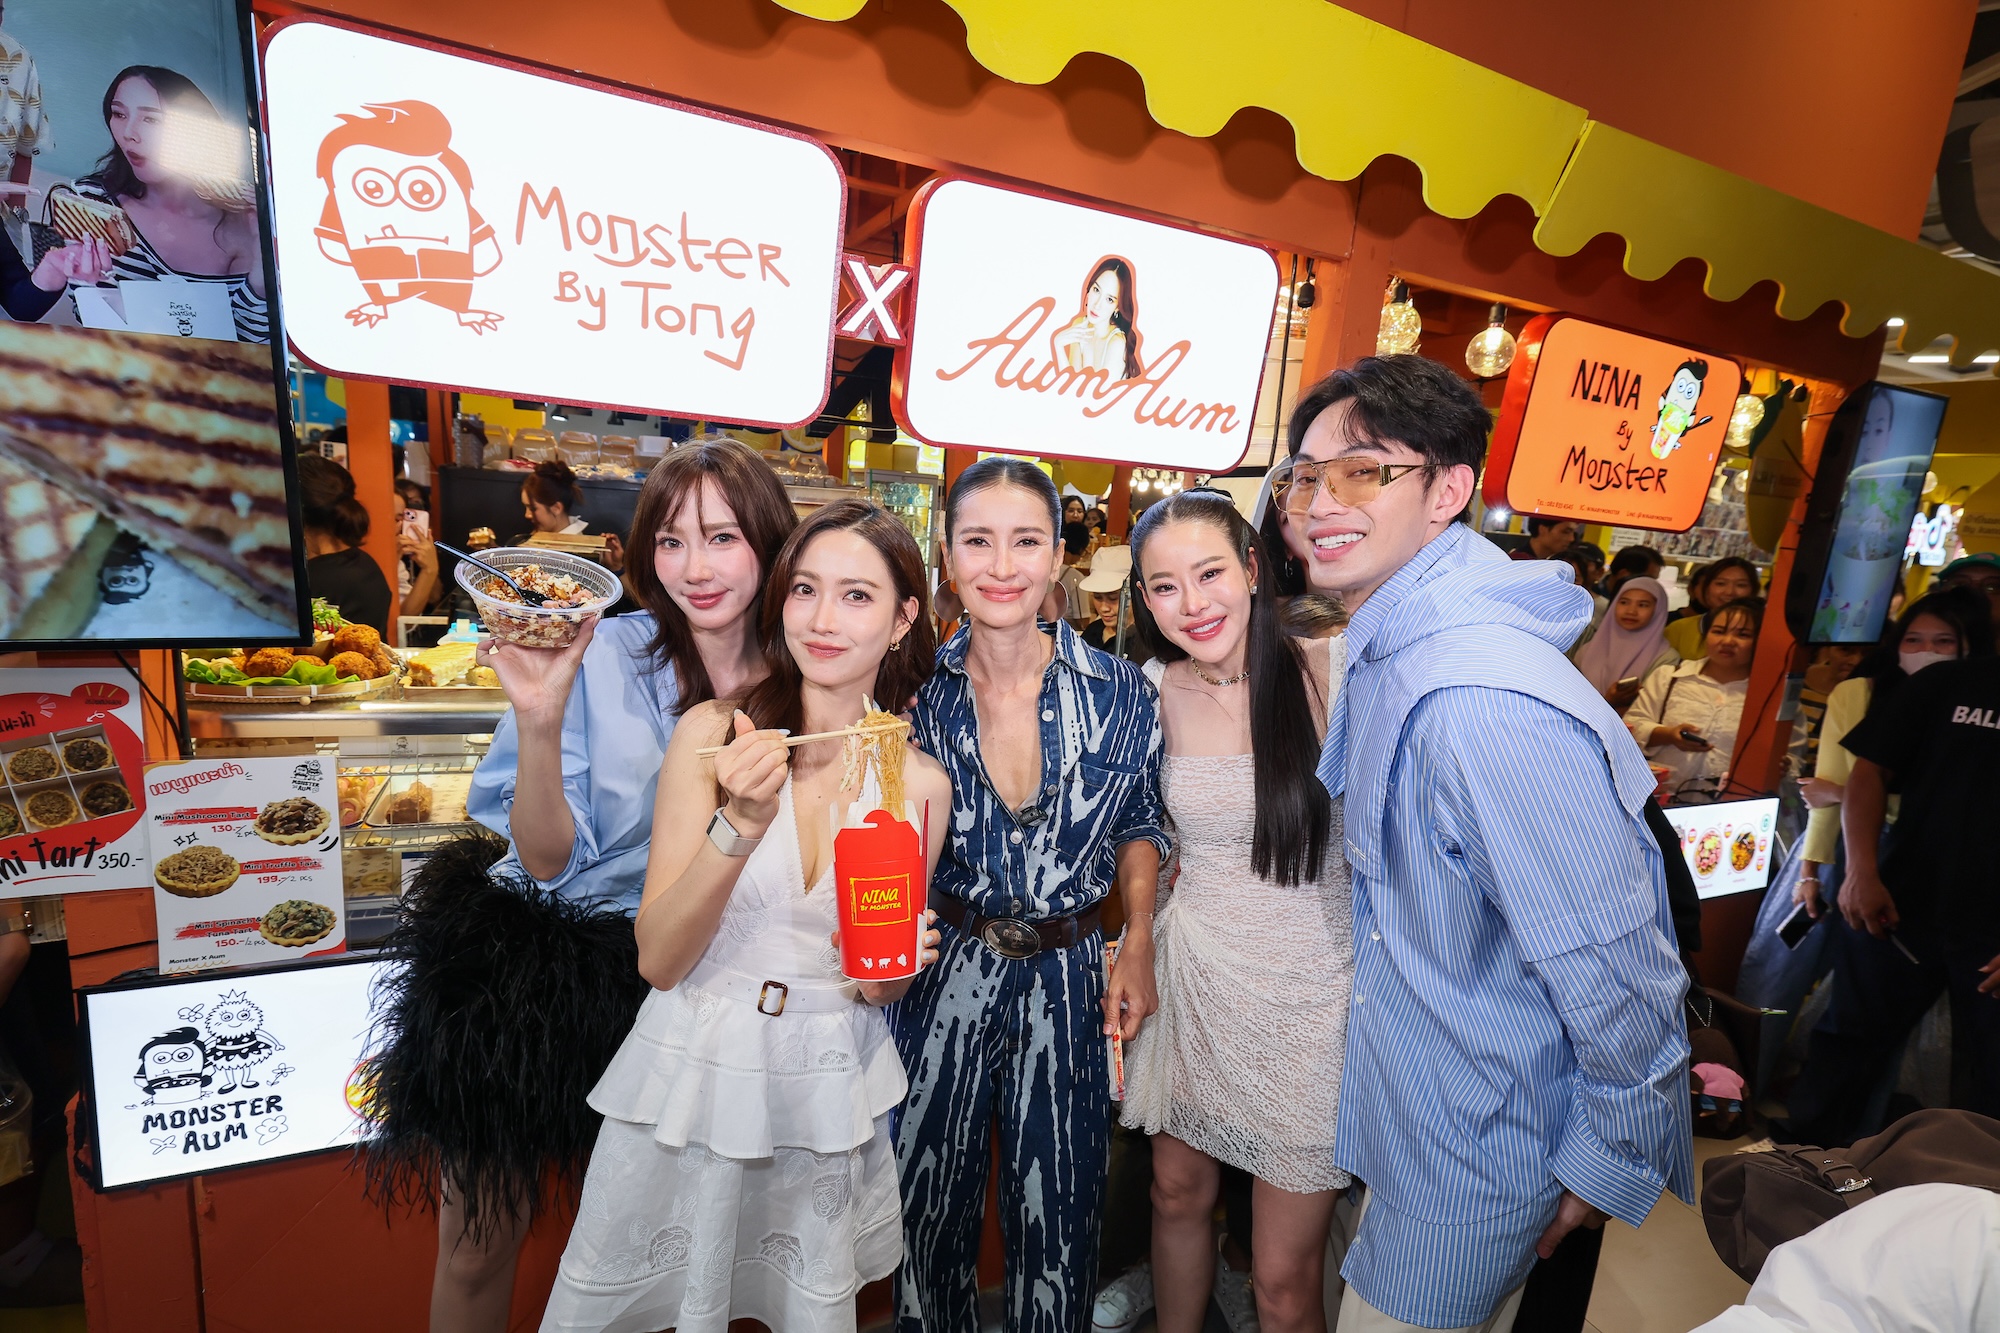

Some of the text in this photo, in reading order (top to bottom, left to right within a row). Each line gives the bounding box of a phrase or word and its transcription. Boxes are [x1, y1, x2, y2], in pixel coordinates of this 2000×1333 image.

[841, 258, 910, 341] X
[553, 270, 755, 371] By Tong
[1571, 359, 1642, 410] NINA
[1616, 420, 1633, 451] By
[149, 762, 244, 796] เมนูแนะนำ
[0, 850, 27, 884] ni
[215, 917, 253, 927] Spinach
[869, 902, 901, 910] MONSTER
[206, 927, 253, 938] Tuna Tart
[142, 1095, 283, 1134] MONSTER
[182, 1122, 248, 1154] AUM
